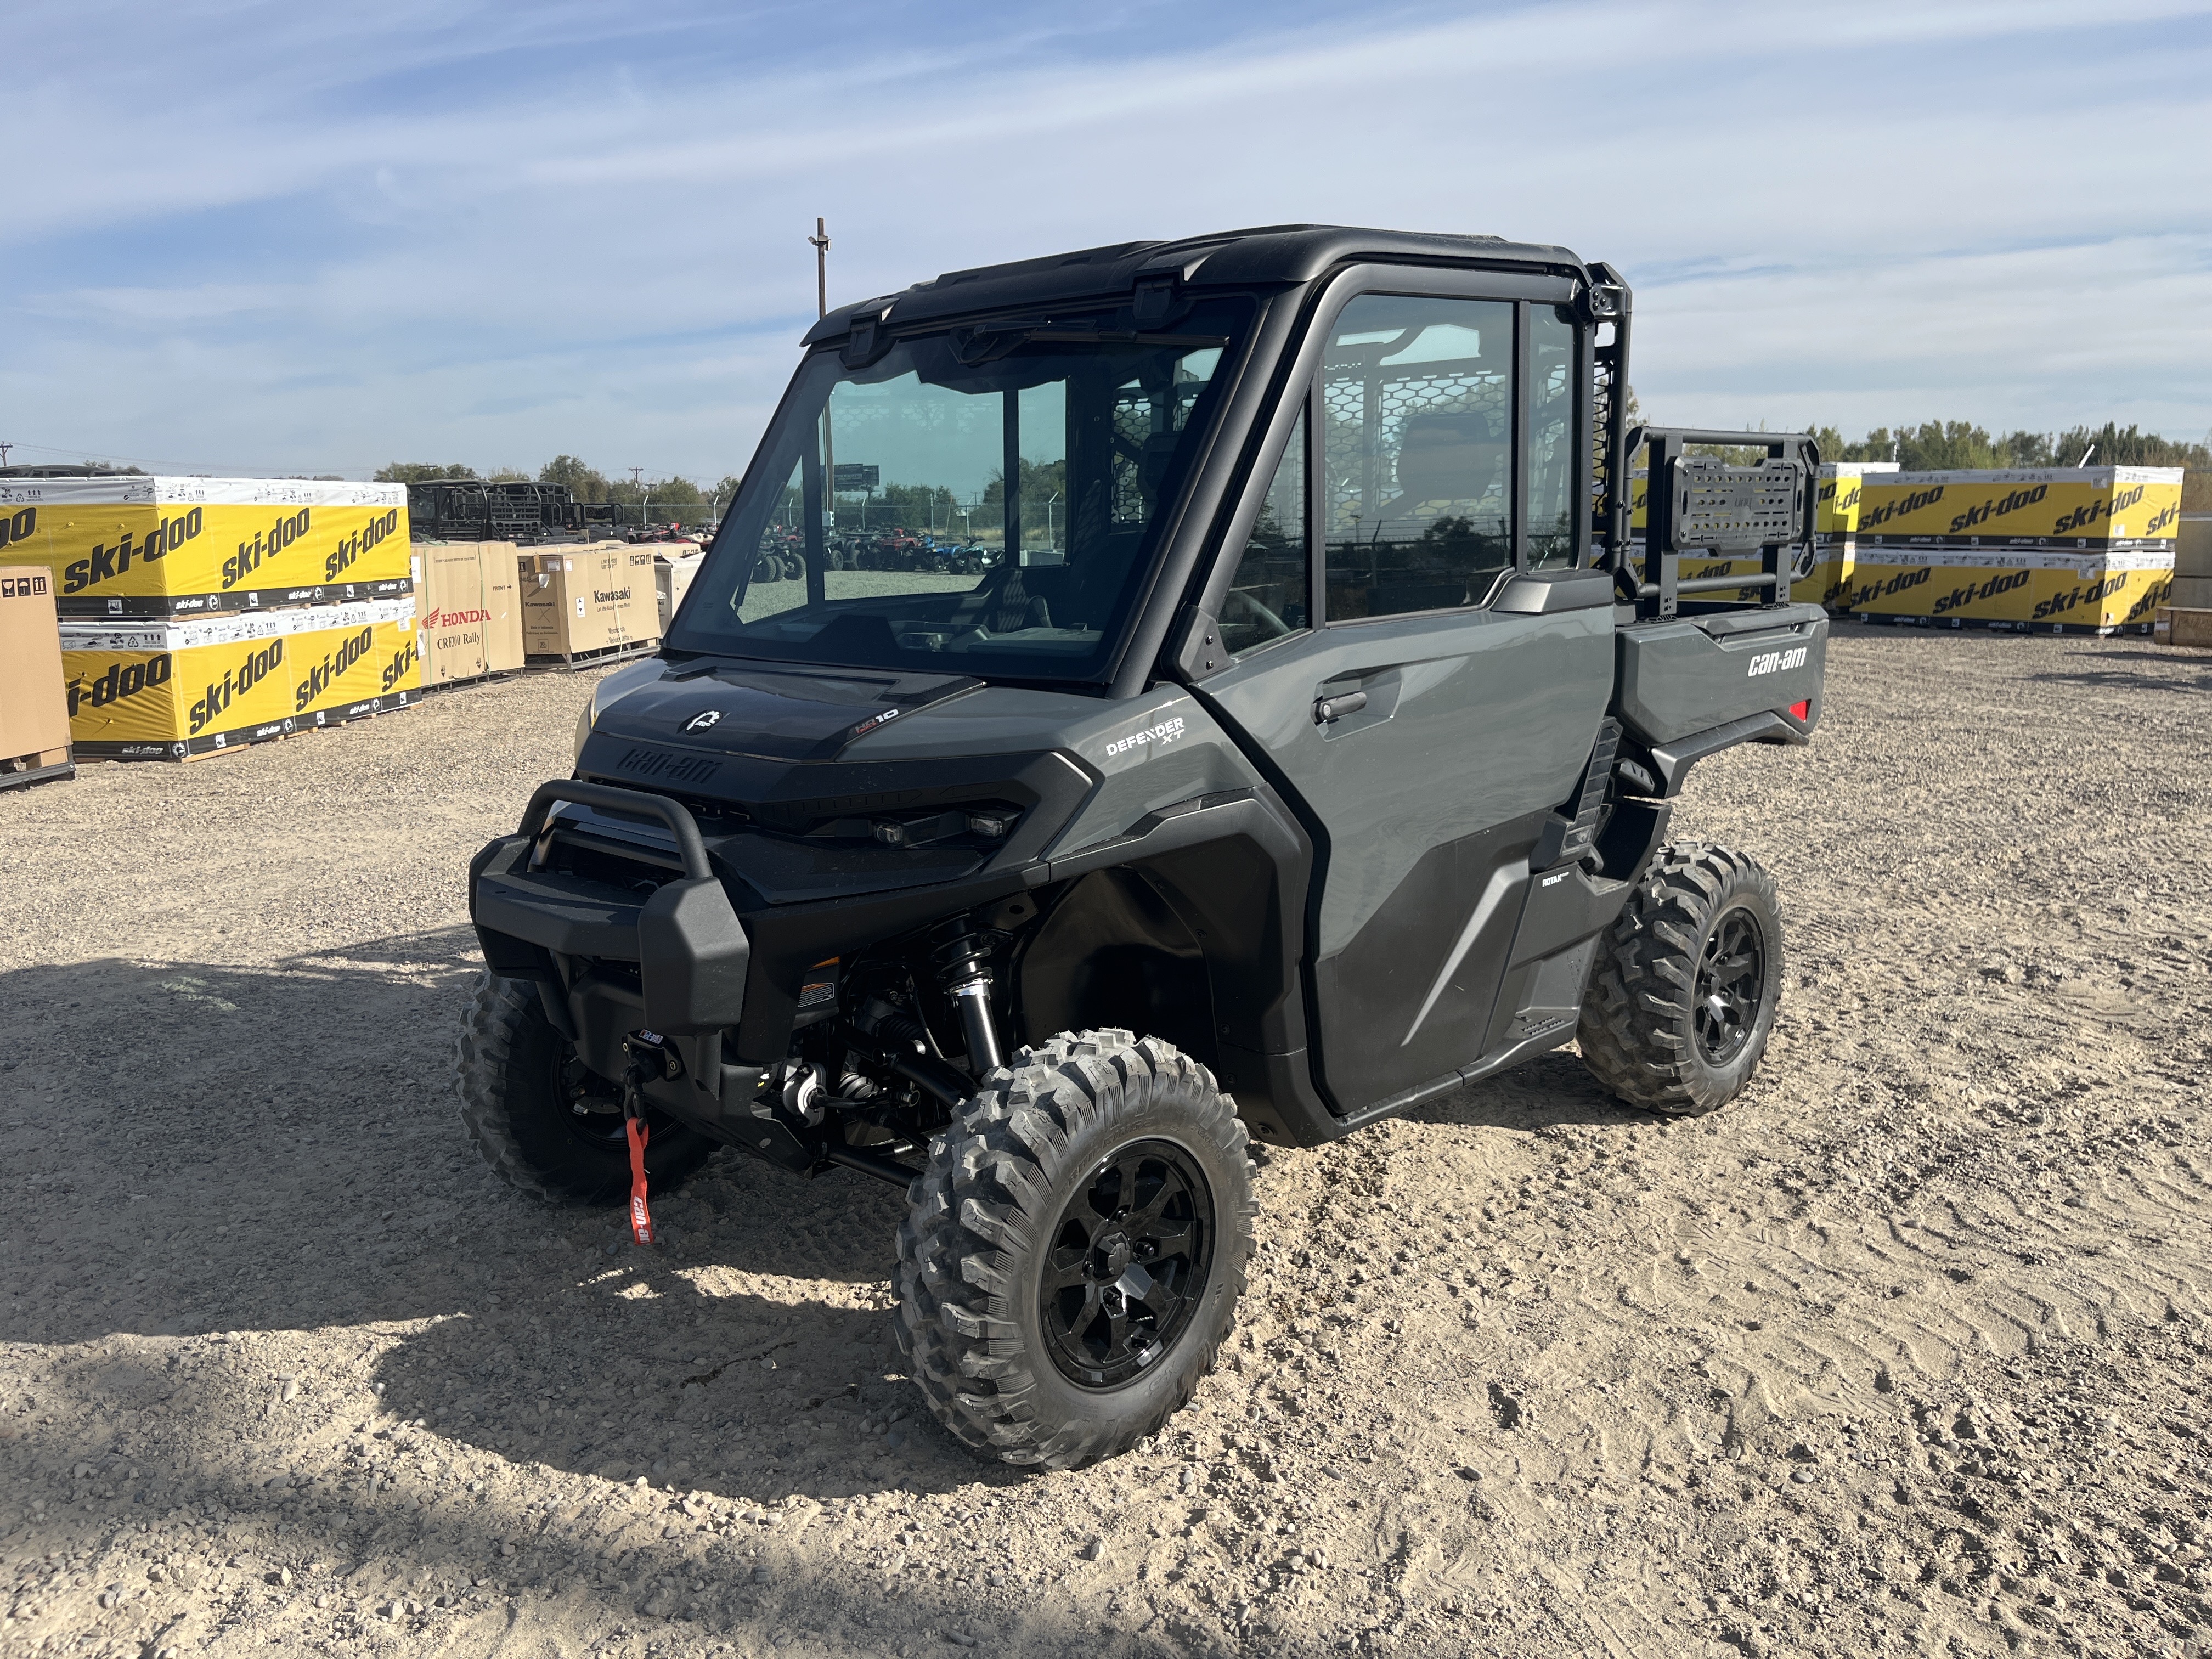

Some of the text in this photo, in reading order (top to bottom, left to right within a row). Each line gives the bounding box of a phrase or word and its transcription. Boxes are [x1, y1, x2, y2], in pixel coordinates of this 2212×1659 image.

[1858, 485, 1944, 532] ski-doo
[1949, 484, 2048, 533] ski-doo
[2053, 484, 2144, 535] ski-doo
[2146, 501, 2180, 535] ski-
[64, 507, 202, 594] ski-doo
[222, 507, 309, 590] ski-doo
[325, 509, 397, 582] ski-doo
[176, 599, 204, 610] ski-doo
[594, 586, 631, 603] Kawasaki
[1933, 569, 2030, 614] ski-doo
[2033, 572, 2128, 620] ski-doo
[437, 631, 481, 650] CRF300 Rally
[441, 609, 492, 627] HONDA
[296, 626, 372, 712] ski-doo
[382, 640, 419, 693] ski-
[1748, 646, 1807, 677] can-am
[68, 653, 172, 717] i-doo
[189, 638, 283, 735] ski-doo
[122, 746, 163, 755] ski-doo
[1105, 717, 1184, 757] DEFENDER
[1161, 729, 1185, 745] XT
[616, 749, 723, 785] can-am
[1542, 874, 1561, 887] ROTAX
